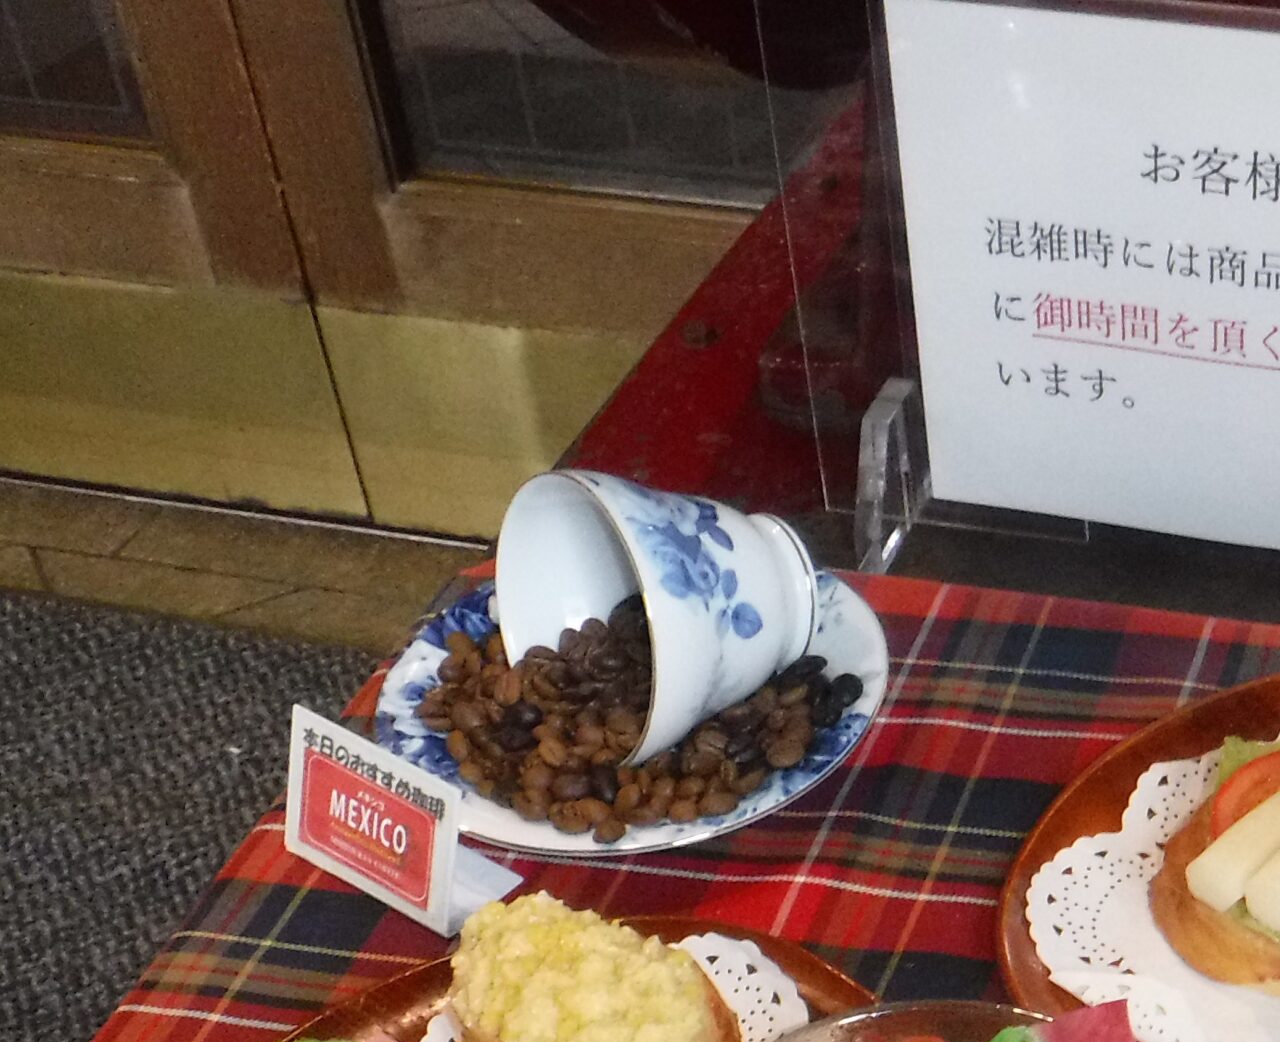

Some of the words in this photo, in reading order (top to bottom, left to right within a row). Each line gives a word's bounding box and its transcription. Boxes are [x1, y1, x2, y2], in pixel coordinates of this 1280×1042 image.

[997, 361, 1136, 409] います。
[328, 788, 407, 855] MEXICO
